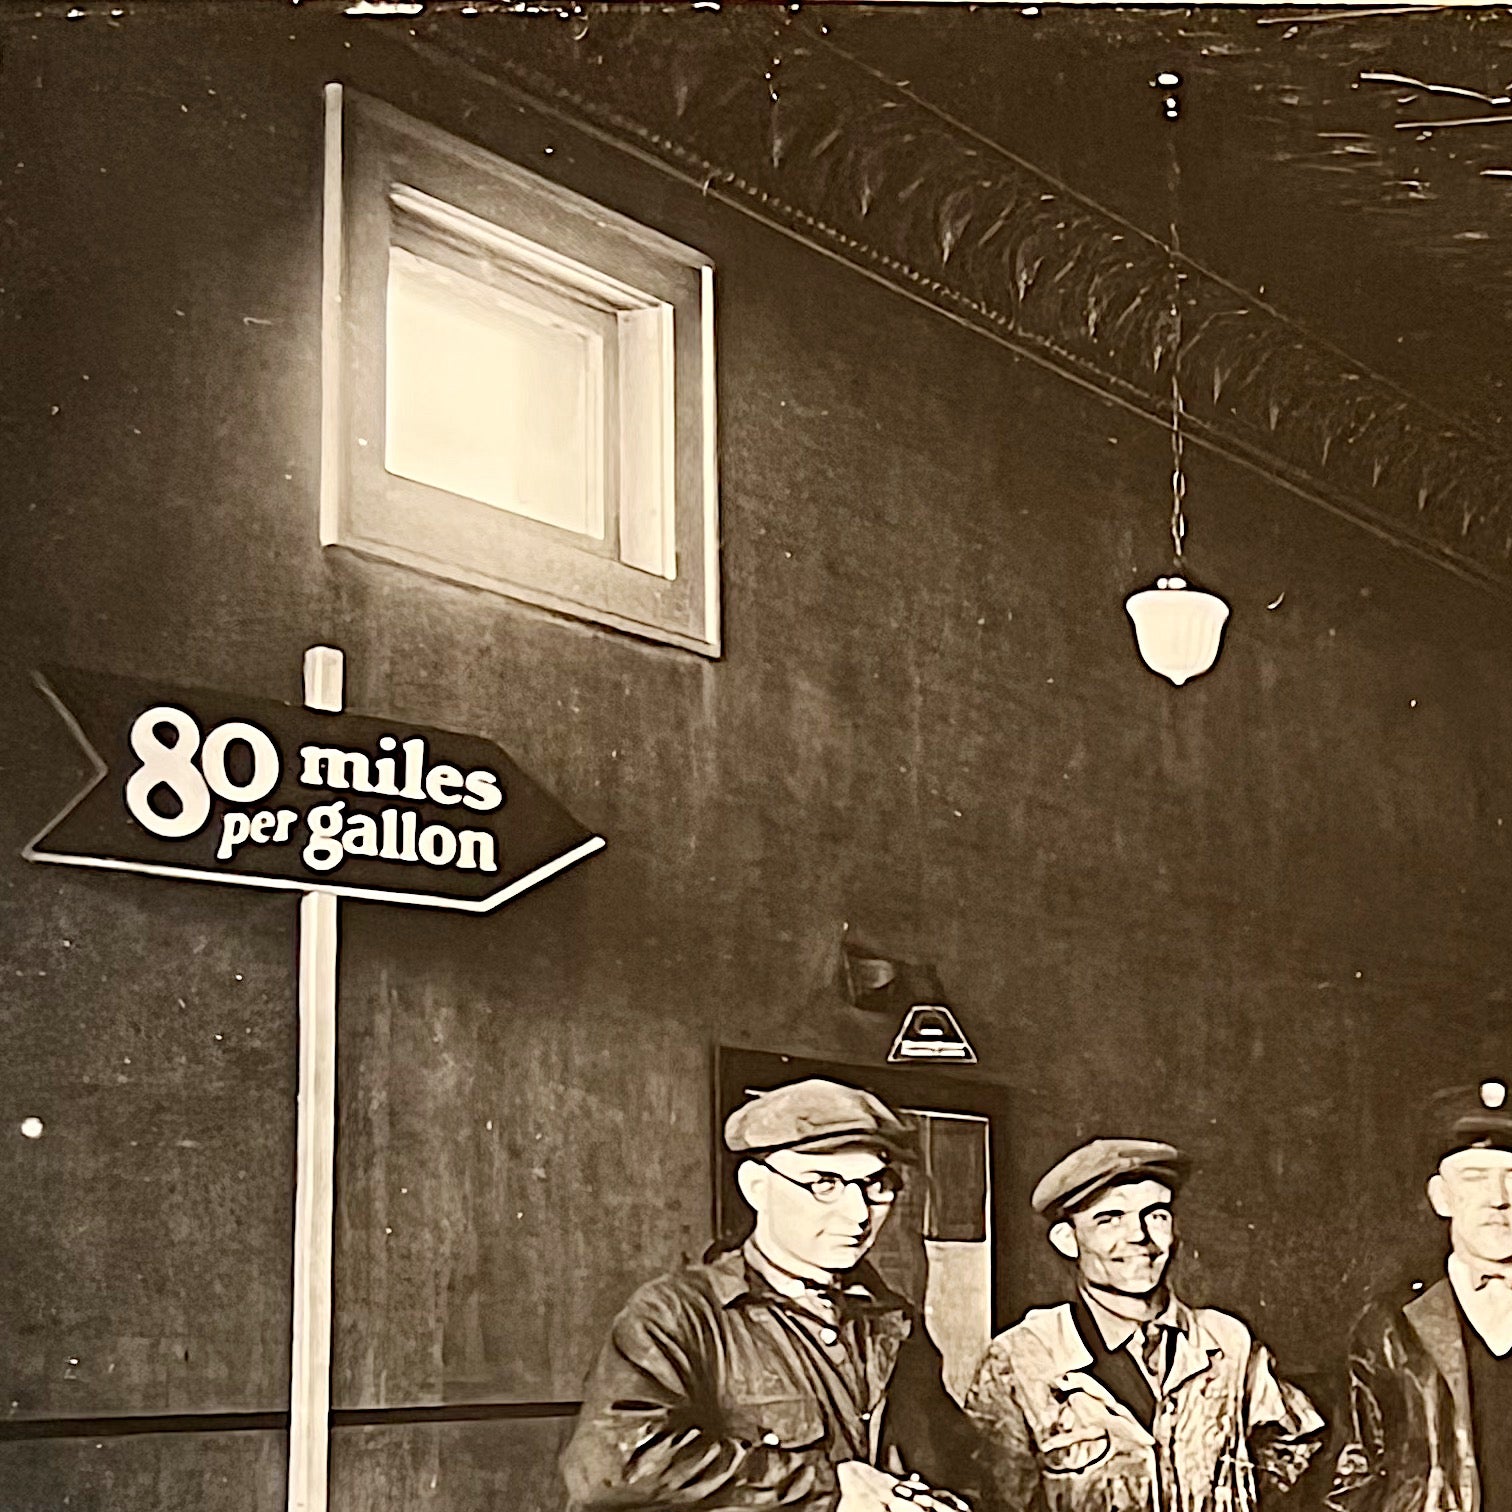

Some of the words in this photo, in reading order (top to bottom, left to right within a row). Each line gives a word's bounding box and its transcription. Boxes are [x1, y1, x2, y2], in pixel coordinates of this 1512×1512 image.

[125, 706, 280, 838] 80
[299, 736, 503, 811] miles
[216, 809, 298, 860] per
[302, 800, 498, 872] gallon
